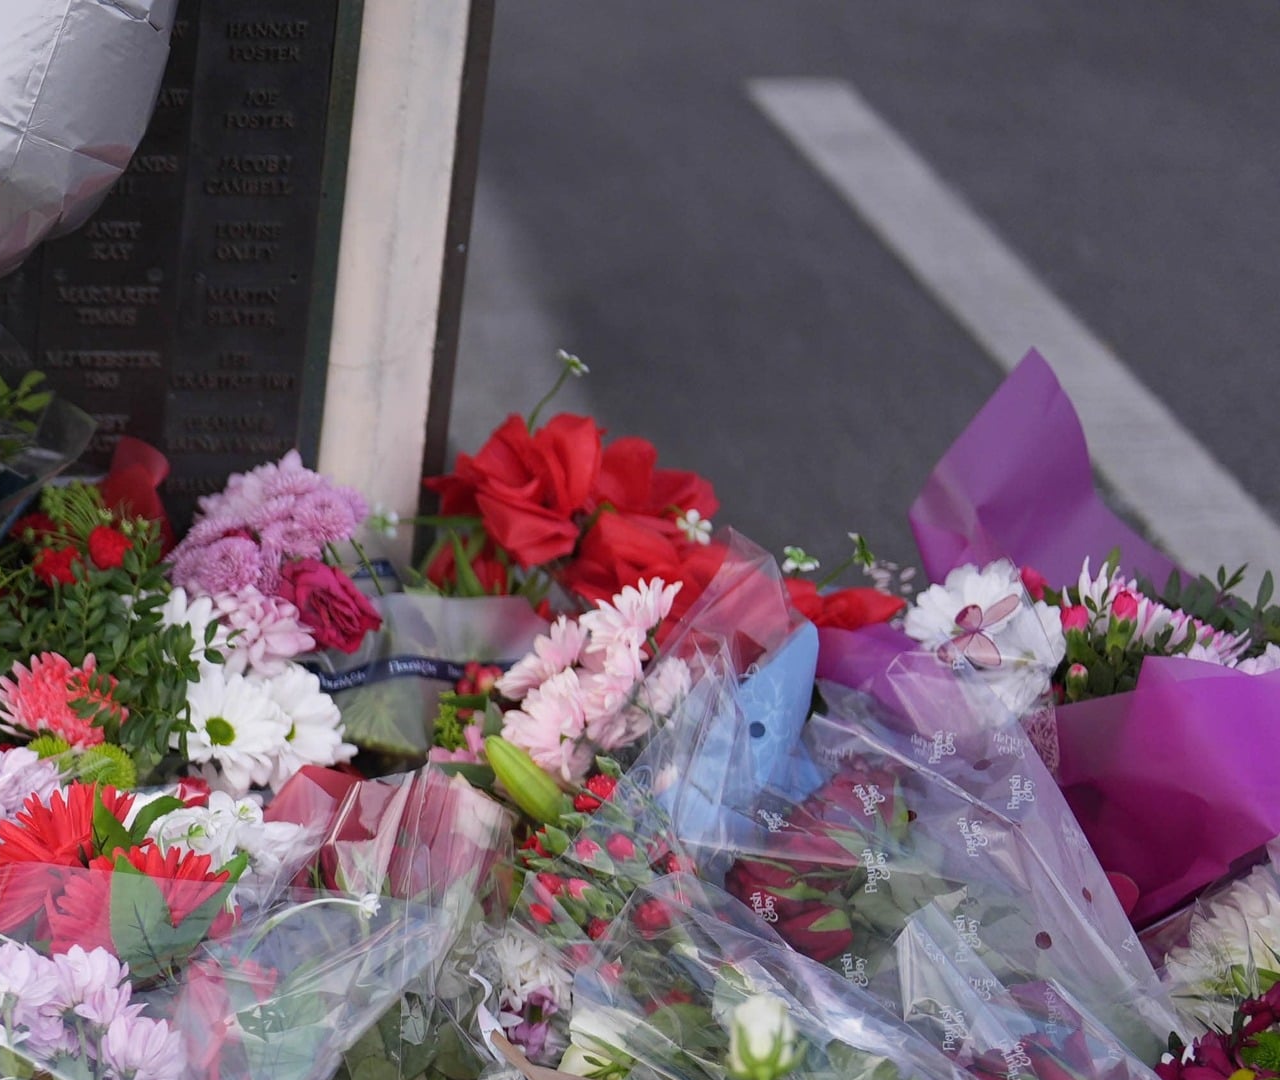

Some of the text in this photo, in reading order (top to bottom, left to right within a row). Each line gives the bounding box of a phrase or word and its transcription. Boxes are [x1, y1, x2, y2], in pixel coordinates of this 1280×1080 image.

[226, 20, 309, 39] HANNAH
[228, 46, 300, 63] FOSTER
[243, 89, 279, 107] JOE
[225, 112, 296, 129] FOSTER
[86, 222, 142, 240] ANDY
